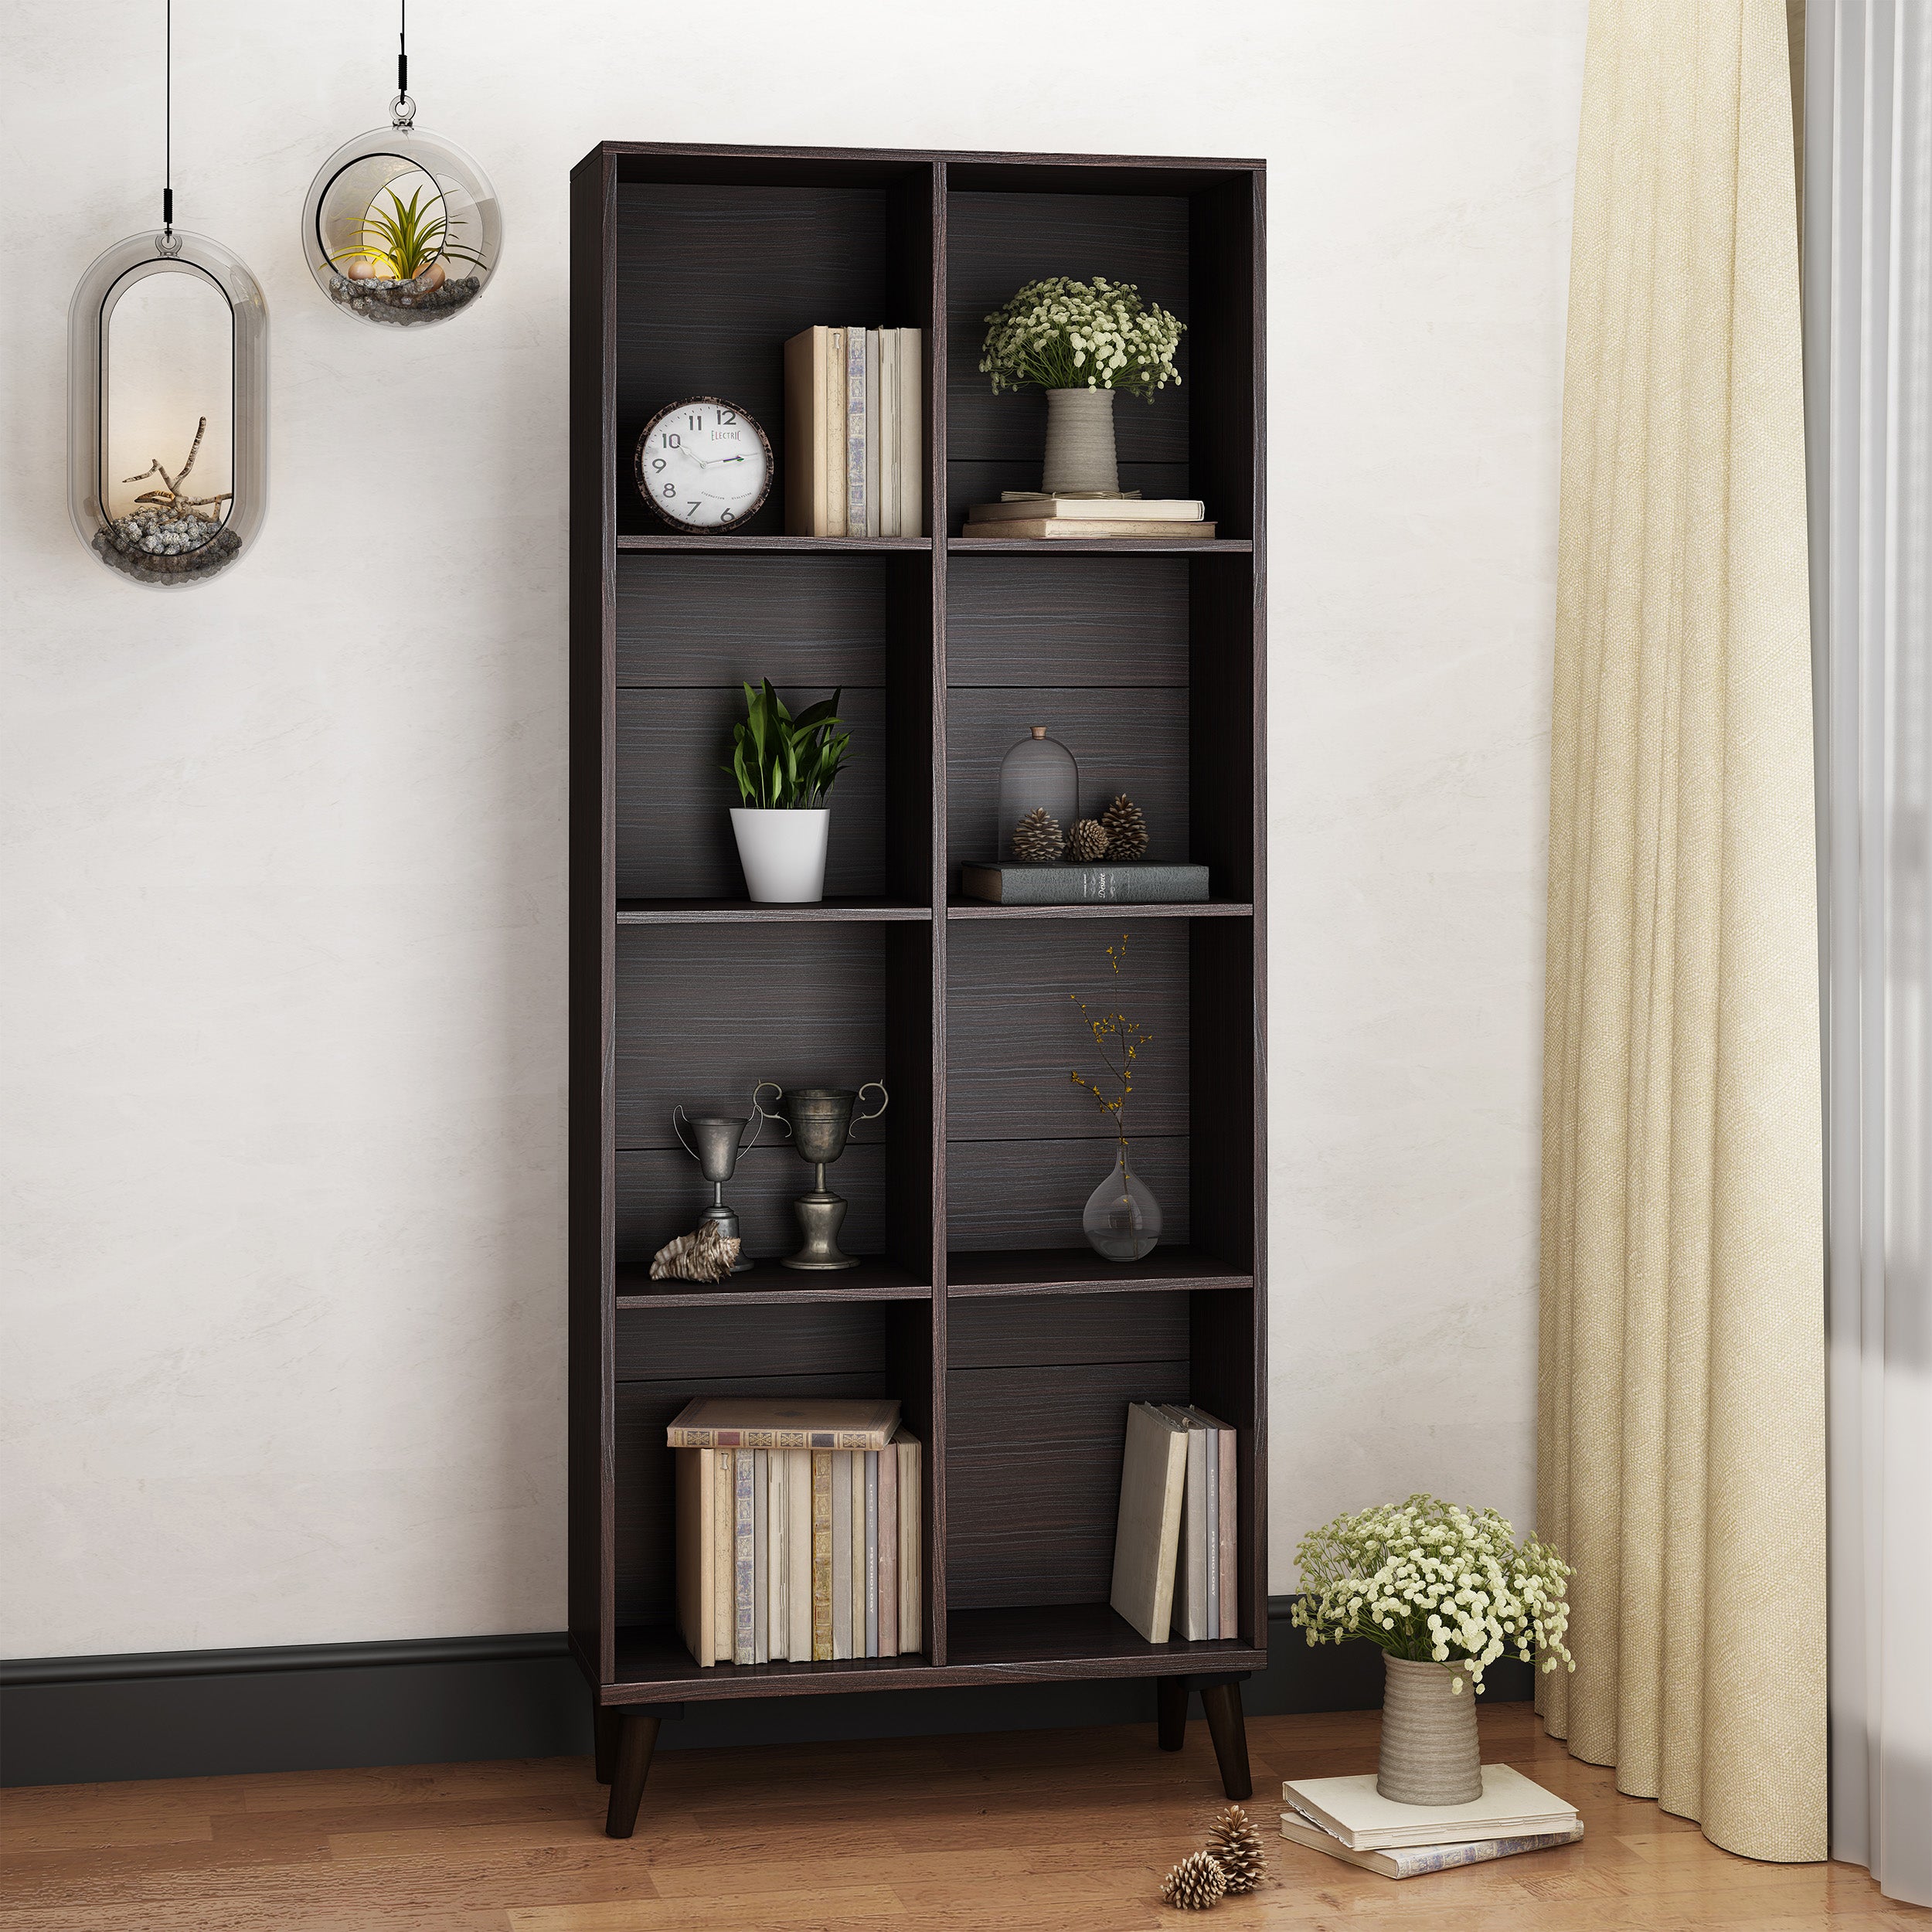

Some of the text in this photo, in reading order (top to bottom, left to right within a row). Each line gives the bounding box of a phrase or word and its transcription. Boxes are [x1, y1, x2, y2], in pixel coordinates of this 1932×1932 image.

[689, 416, 702, 430] 11
[716, 410, 736, 425] 12
[662, 433, 681, 449] 10
[652, 458, 667, 474] 9
[662, 483, 676, 498] 8
[687, 502, 702, 516] 7
[720, 508, 736, 523] 6
